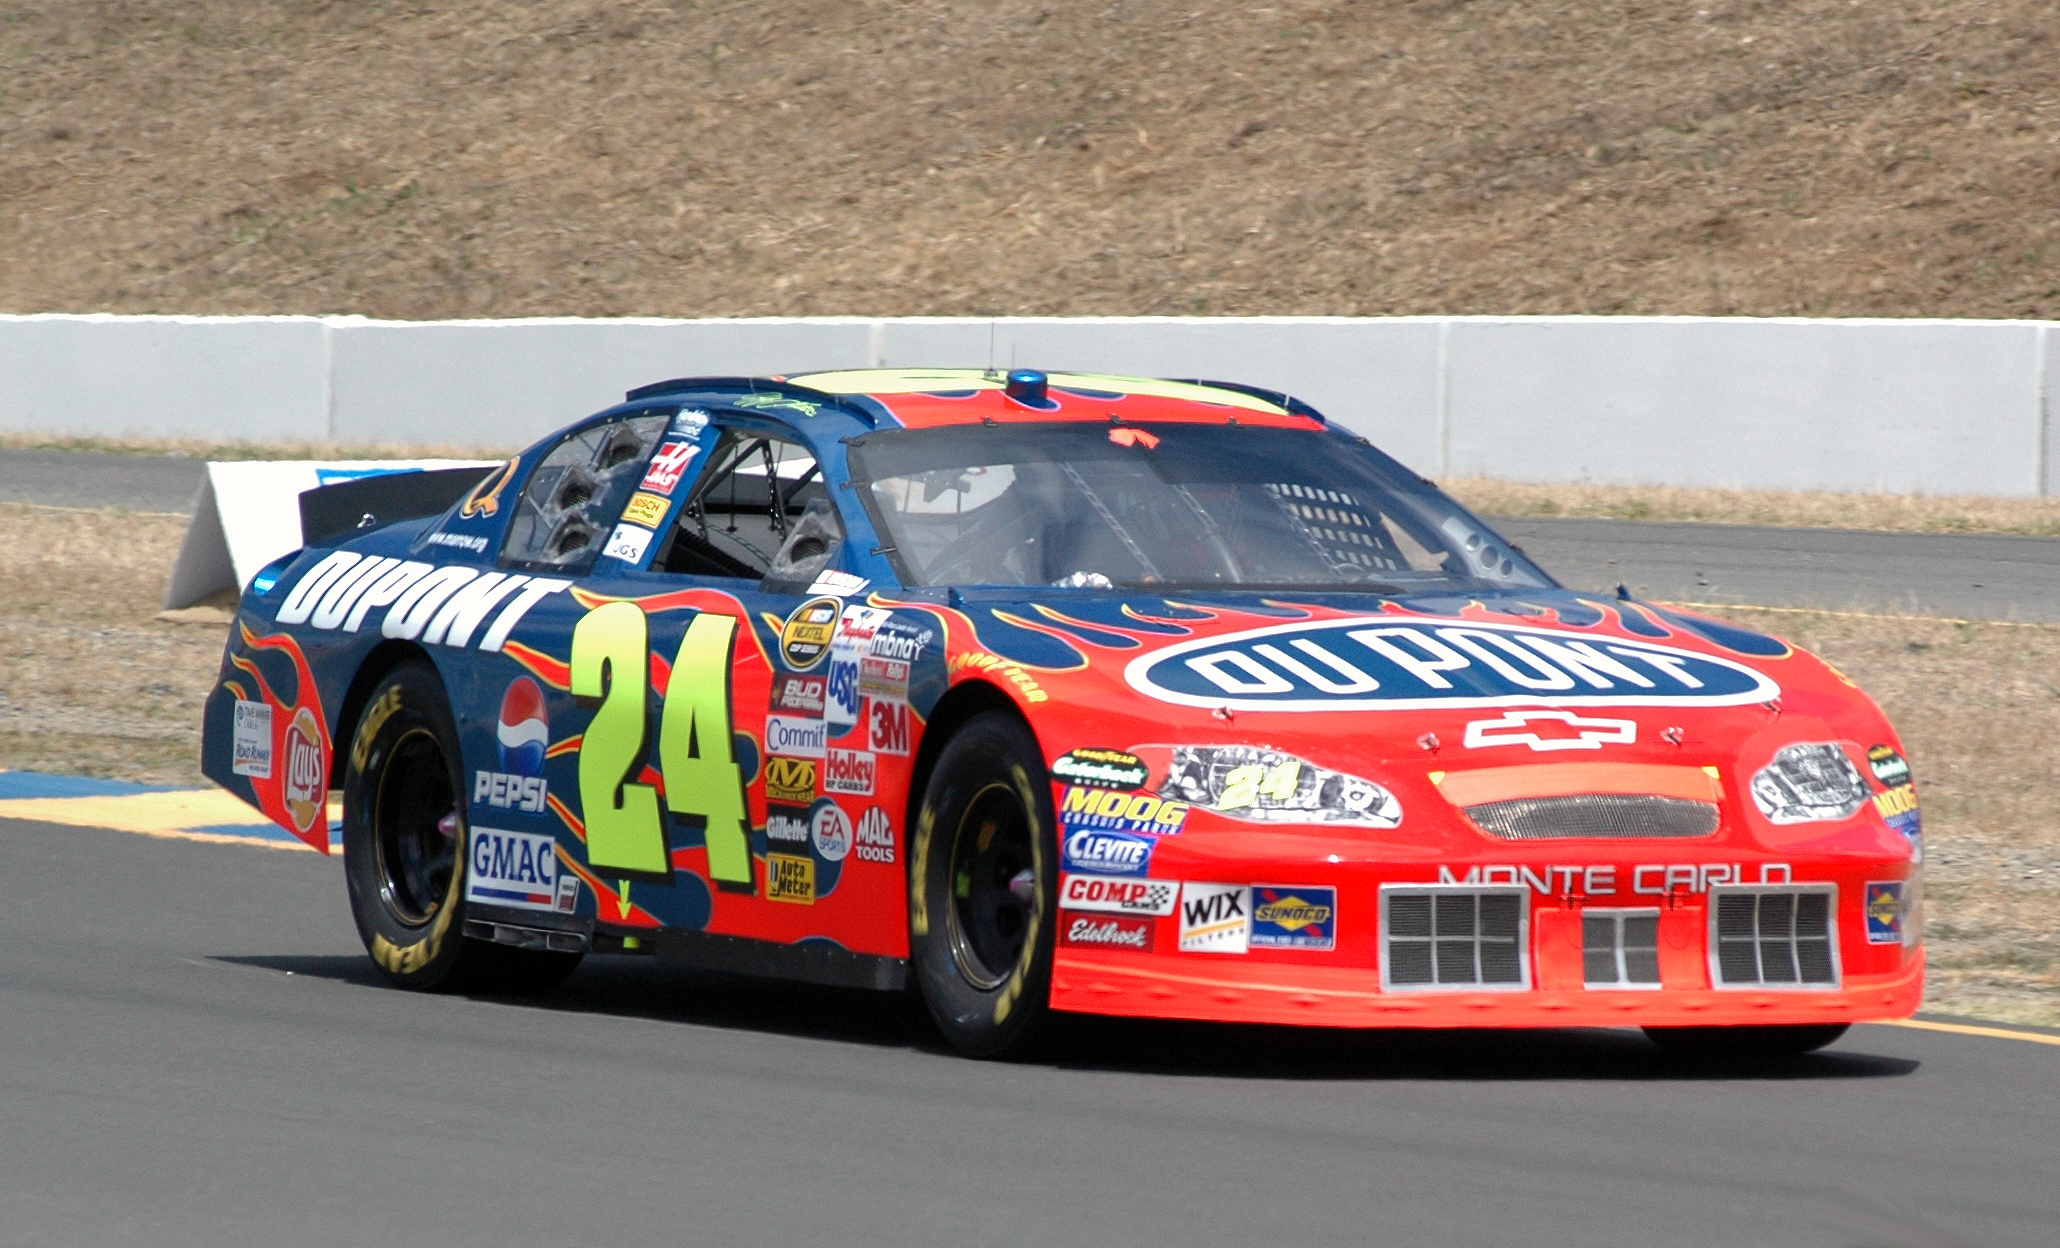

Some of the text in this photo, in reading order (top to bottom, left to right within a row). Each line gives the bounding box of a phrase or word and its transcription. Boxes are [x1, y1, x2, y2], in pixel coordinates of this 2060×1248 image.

[275, 551, 573, 653] DUPONT
[1185, 627, 1705, 695] DU PONT
[785, 680, 822, 699] BUD
[570, 600, 754, 888] 24
[871, 701, 908, 752] 3M
[827, 748, 874, 792] Holley
[1217, 761, 1303, 811] 24
[474, 770, 548, 812] PEPSI
[1062, 786, 1190, 826] MOOG
[766, 815, 809, 842] Gillette
[856, 806, 895, 847] MAC
[1067, 829, 1149, 863] CLEVITE
[474, 832, 554, 886] GMAC
[780, 860, 805, 879] Auto
[856, 845, 895, 863] TOOLS
[779, 876, 811, 896] Meter
[1068, 880, 1147, 902] COMP
[1438, 863, 1792, 895] MONTE CARLO
[1184, 889, 1244, 928] WIX
[1258, 905, 1328, 921] SUNOCO
